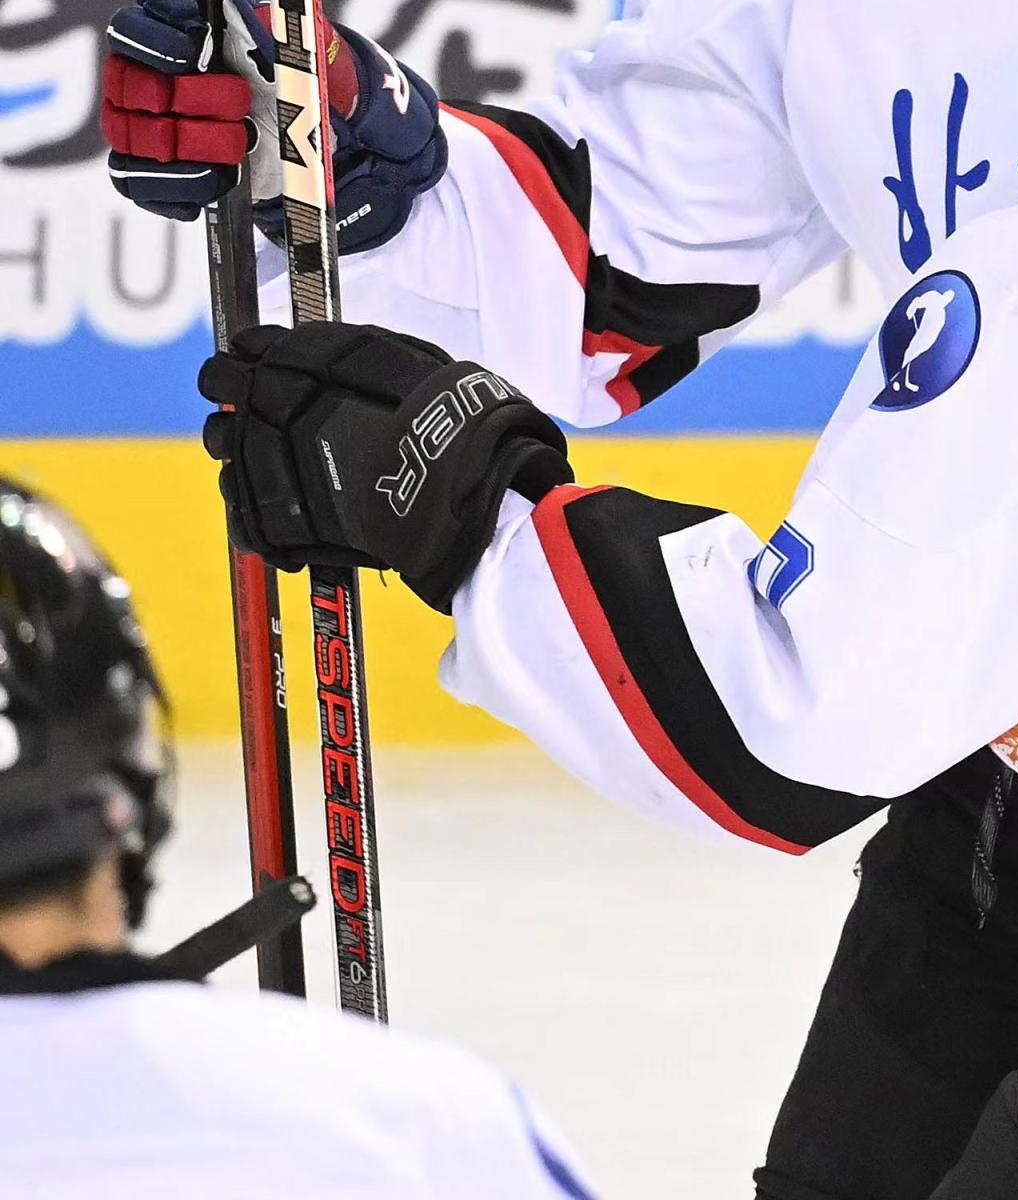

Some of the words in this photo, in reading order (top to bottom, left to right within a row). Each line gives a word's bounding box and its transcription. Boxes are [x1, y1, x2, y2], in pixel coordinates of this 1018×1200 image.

[335, 203, 372, 232] BAU
[376, 372, 520, 517] UER
[273, 652, 288, 709] PRO
[310, 585, 365, 914] TSPEED
